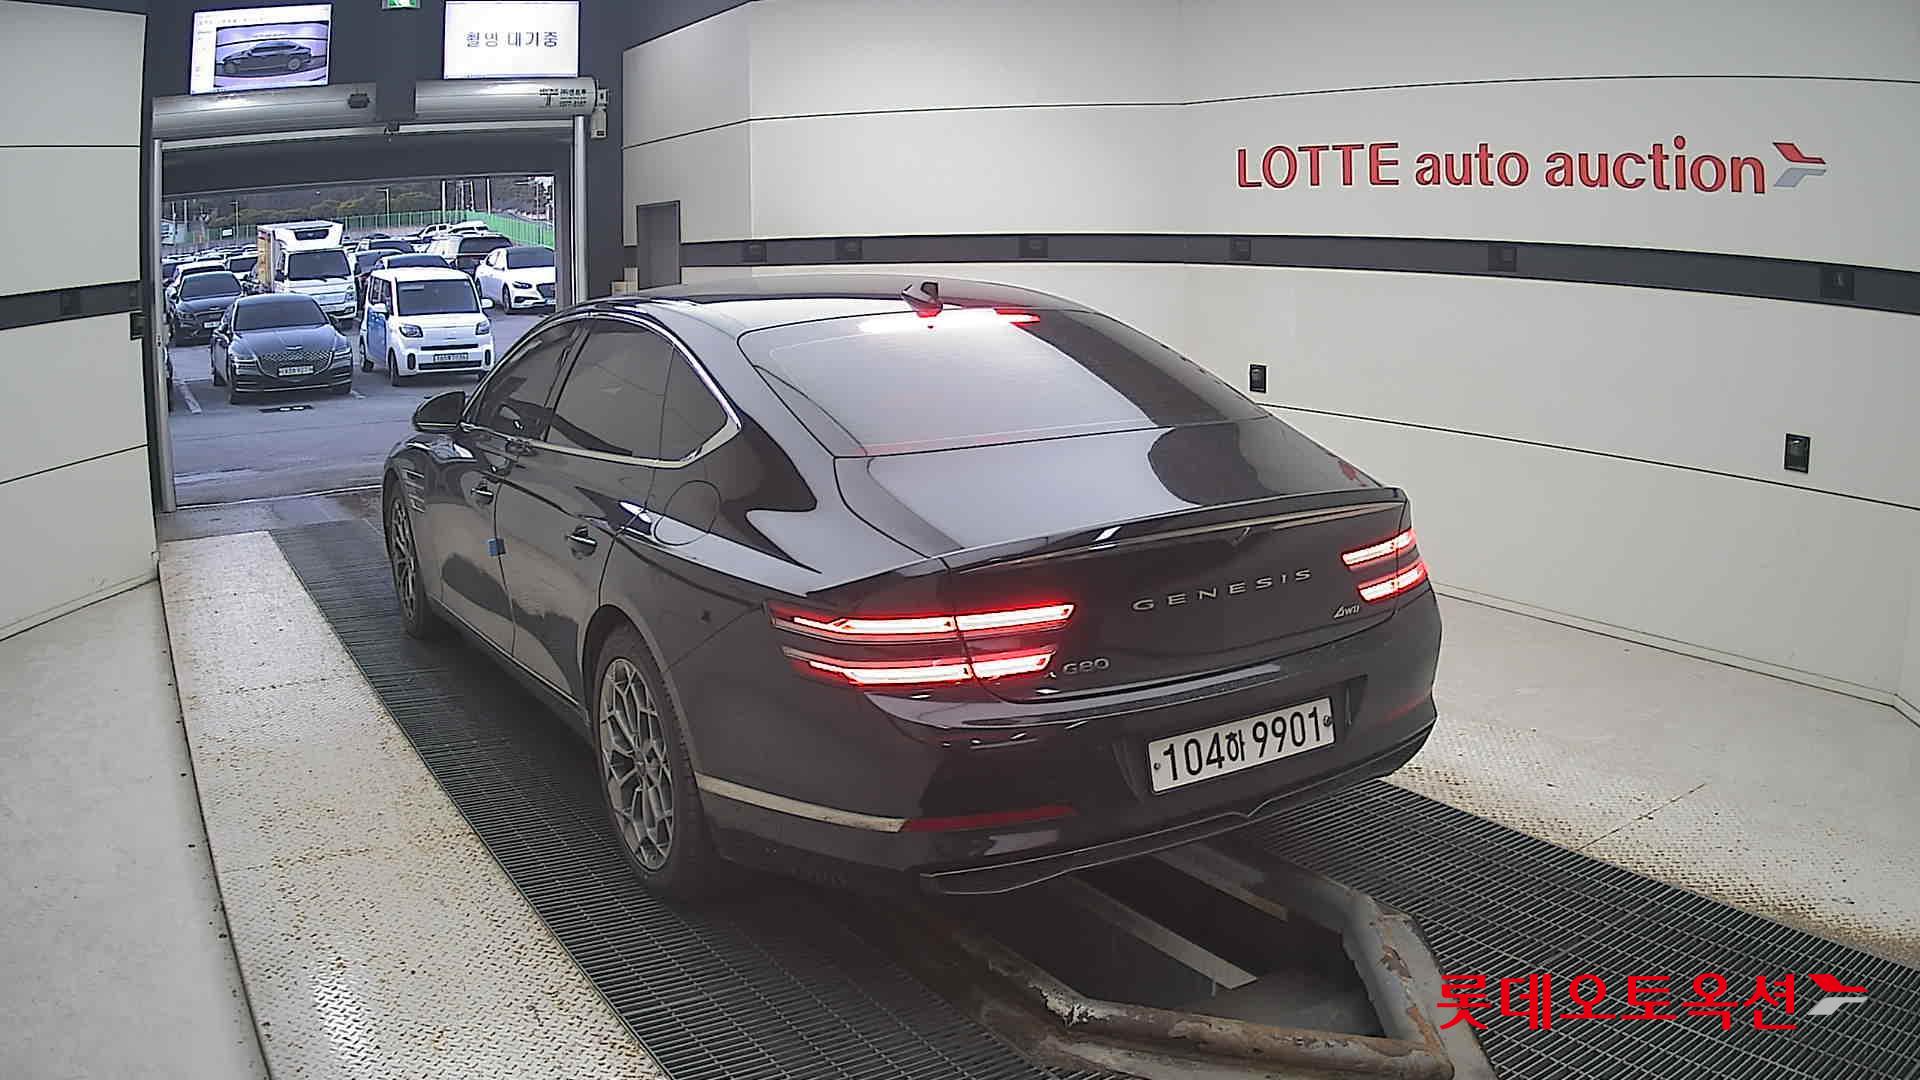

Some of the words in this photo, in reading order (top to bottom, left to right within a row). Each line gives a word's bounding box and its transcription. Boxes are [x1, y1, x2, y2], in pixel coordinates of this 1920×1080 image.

[507, 31, 558, 48] 대기중
[1236, 142, 1400, 189] LOTTE
[1415, 142, 1530, 188] auto
[1544, 135, 1766, 195] auction
[1131, 569, 1312, 611] GENESIS
[1063, 658, 1110, 675] G80
[1162, 729, 1246, 781] 104하
[1251, 705, 1321, 758] 9901
